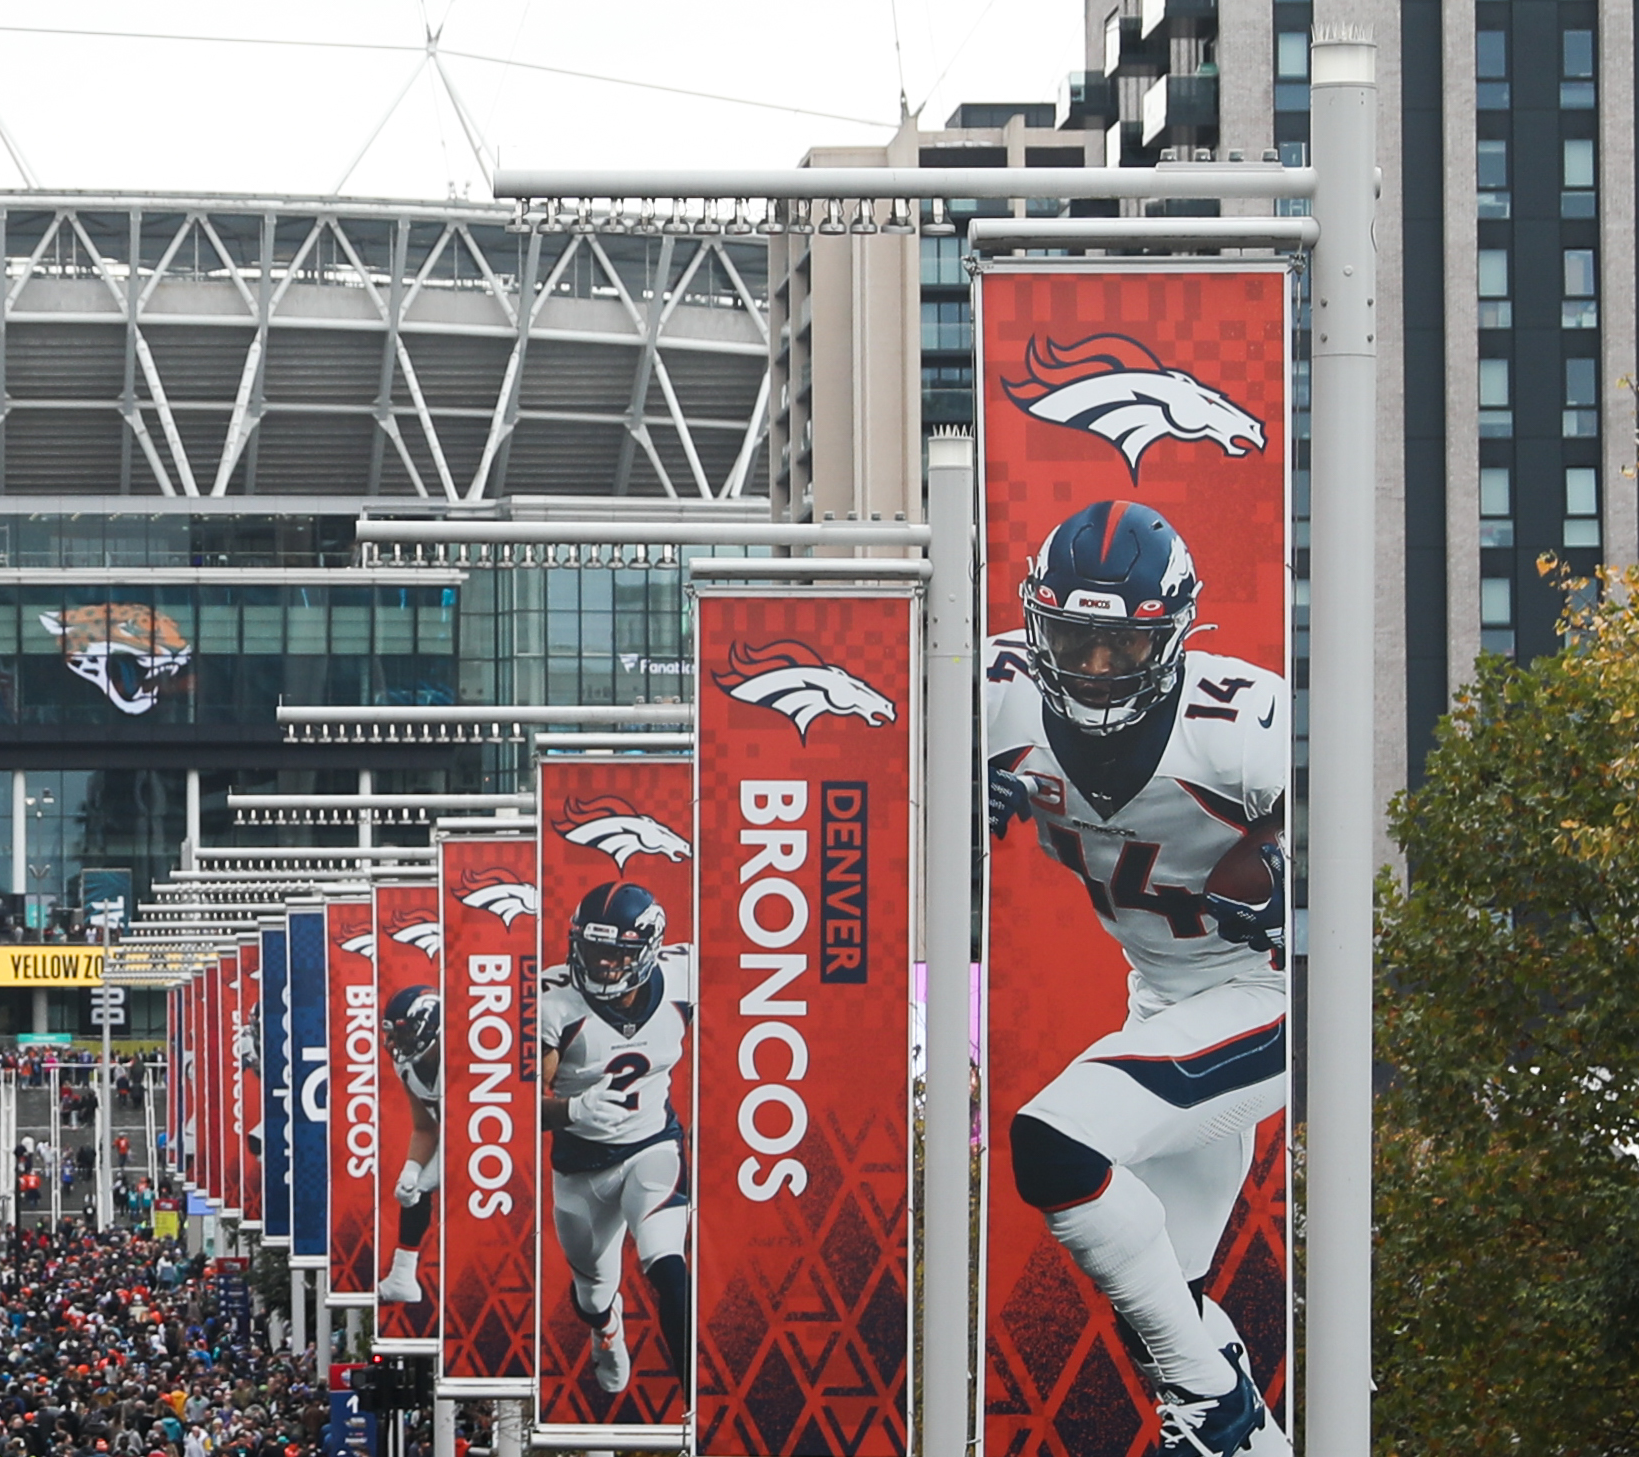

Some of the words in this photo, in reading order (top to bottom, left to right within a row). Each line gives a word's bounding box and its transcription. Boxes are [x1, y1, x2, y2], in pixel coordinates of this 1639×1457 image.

[11, 954, 79, 980] YELLOW
[826, 788, 861, 977] DENVER
[1047, 822, 1209, 939] 14
[739, 778, 809, 1202] BRONCOS
[467, 953, 513, 1221] BRONCOS
